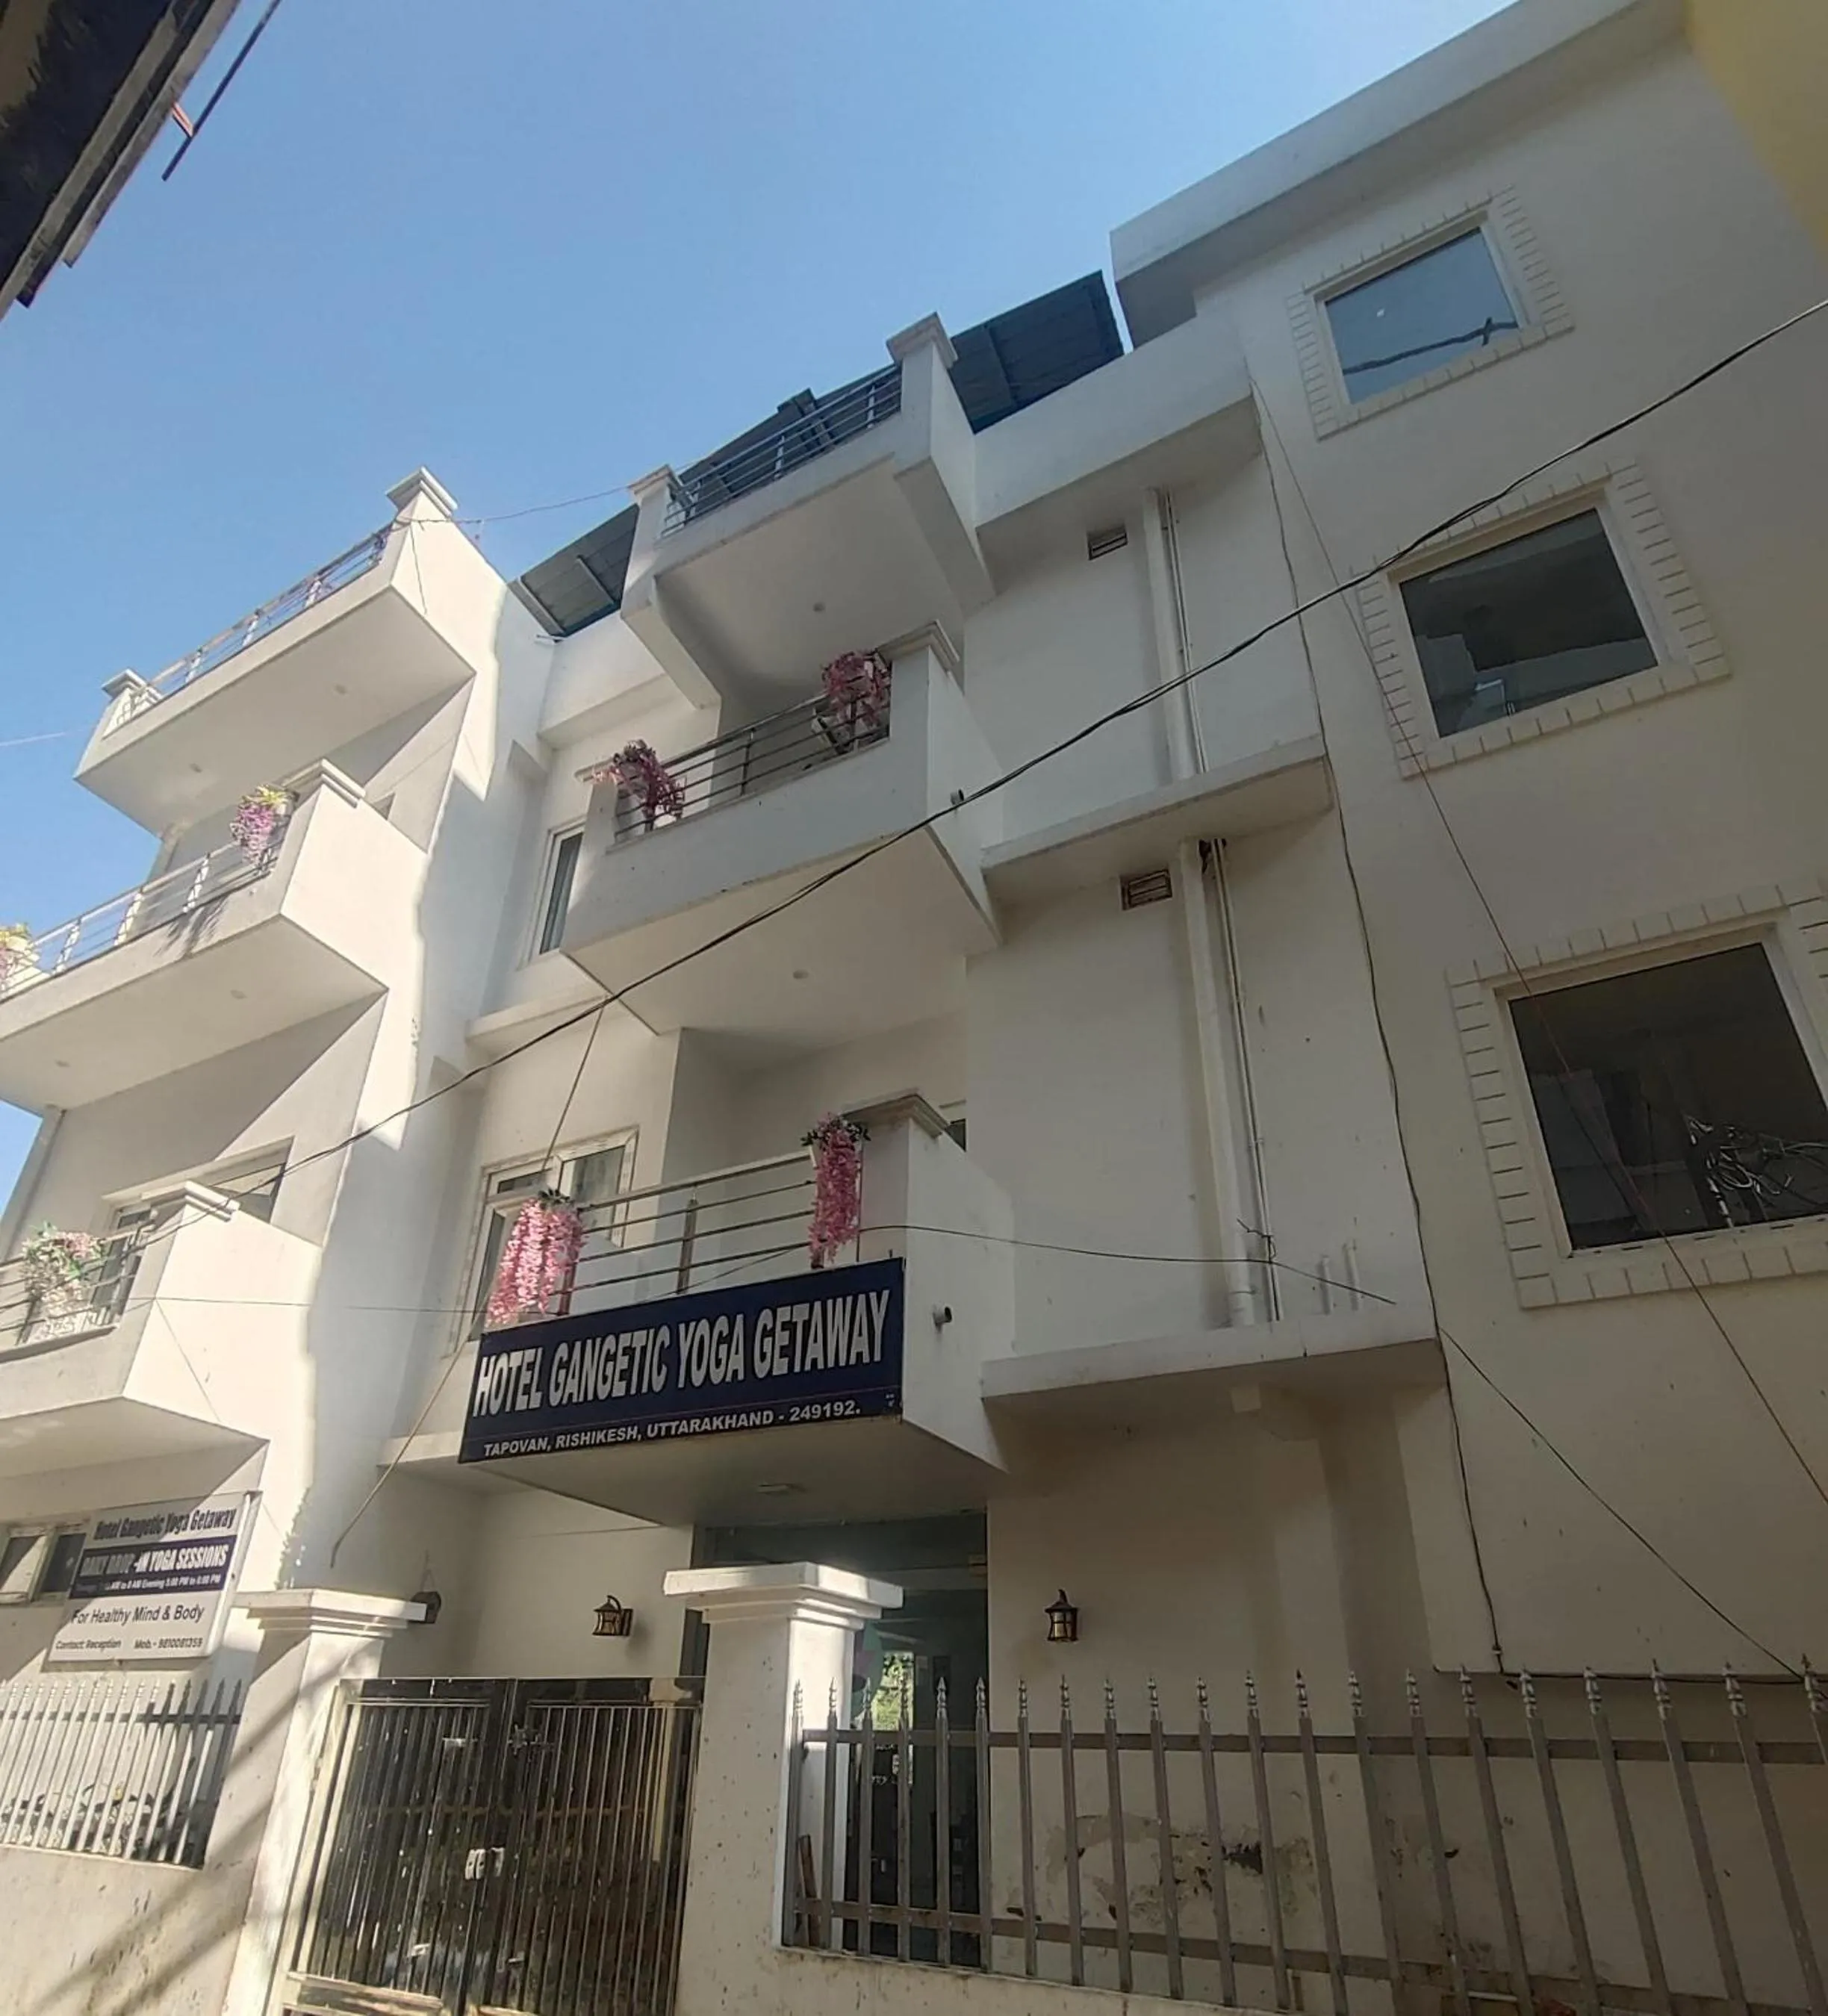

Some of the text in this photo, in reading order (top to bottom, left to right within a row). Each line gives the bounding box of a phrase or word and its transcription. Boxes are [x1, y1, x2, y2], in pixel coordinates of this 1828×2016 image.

[473, 1290, 890, 1417] HOTEL GANGETIC YOGA GETAWAY
[484, 1435, 551, 1457] TAPOVAN,
[556, 1425, 643, 1449] RISHIKESH,
[647, 1410, 774, 1438] UTTARAKHAND
[790, 1399, 861, 1422] 249192.
[164, 1512, 190, 1534] Yoga
[190, 1509, 237, 1529] Getaway
[149, 1549, 178, 1572] YOGA
[175, 1544, 229, 1569] SESSIONS
[72, 1604, 205, 1626] For Healthy Mind & Body
